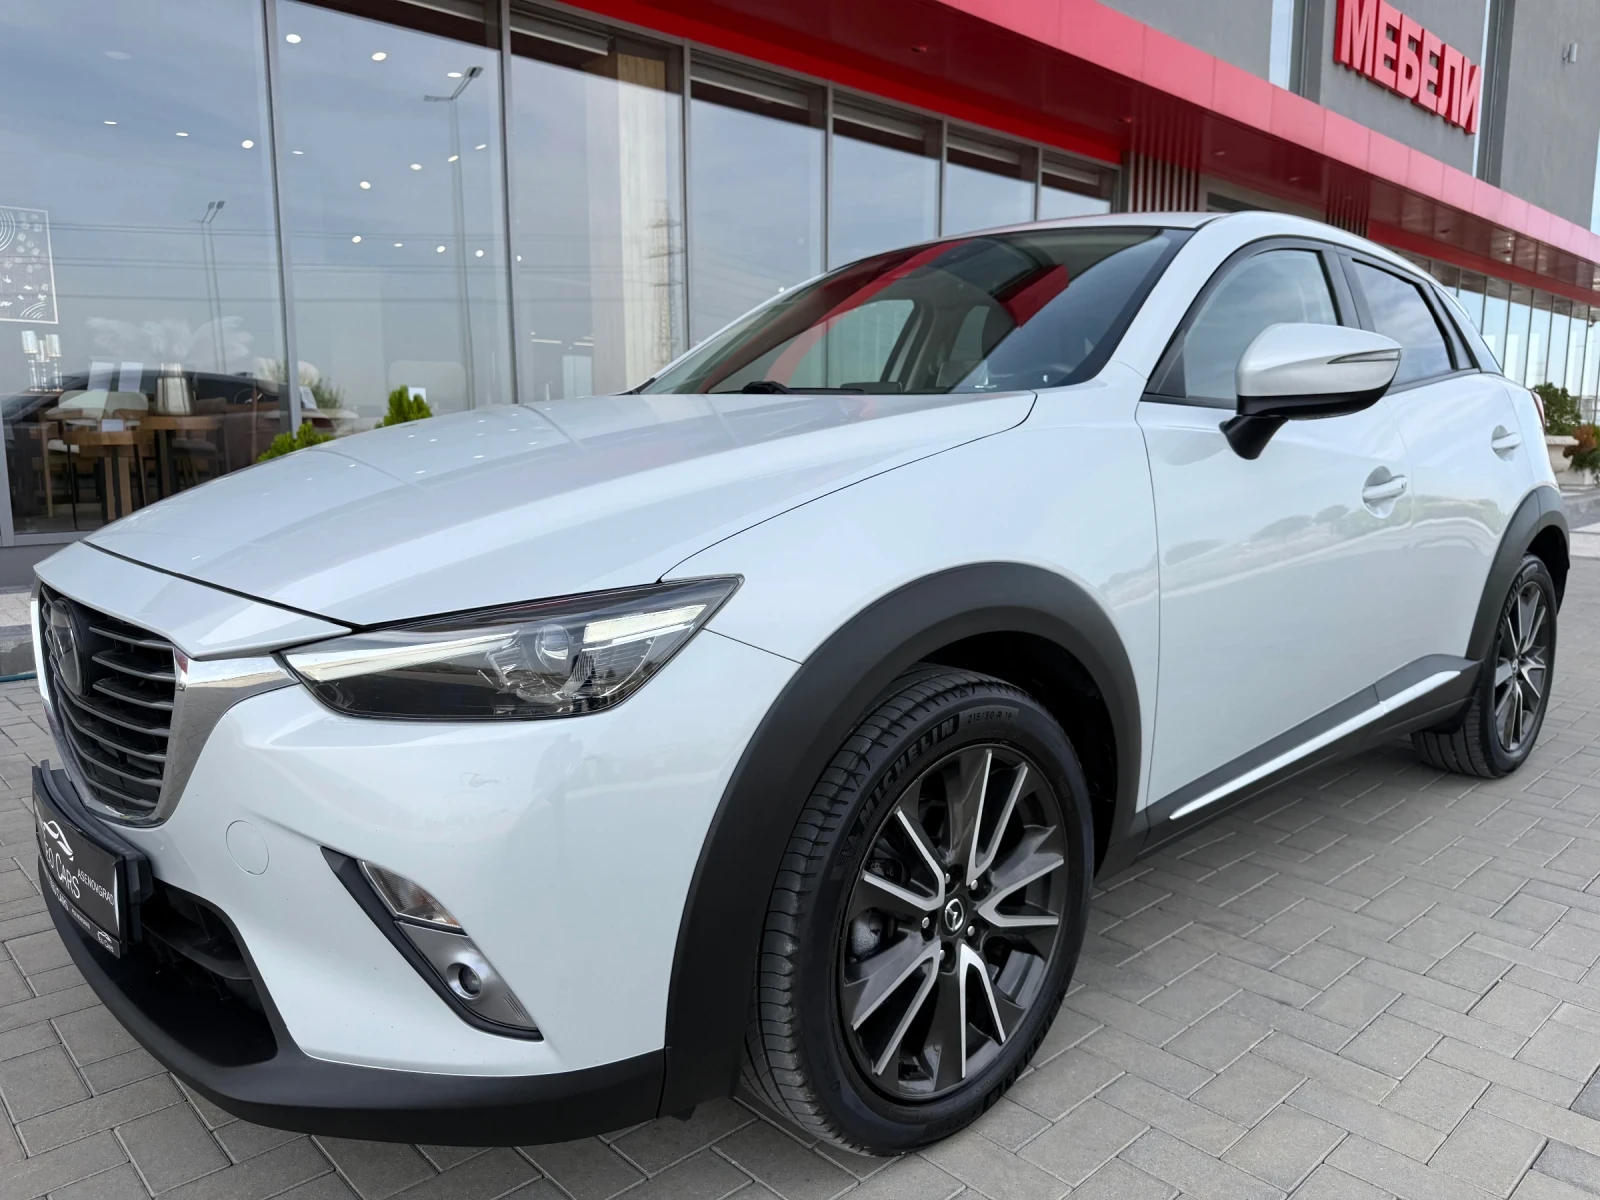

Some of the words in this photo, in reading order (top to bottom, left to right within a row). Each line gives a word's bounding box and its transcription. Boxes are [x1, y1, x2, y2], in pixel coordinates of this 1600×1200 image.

[1334, 0, 1482, 134] МЕБЕЛИ
[859, 716, 956, 829] MICHELIN
[55, 852, 81, 899] CARS
